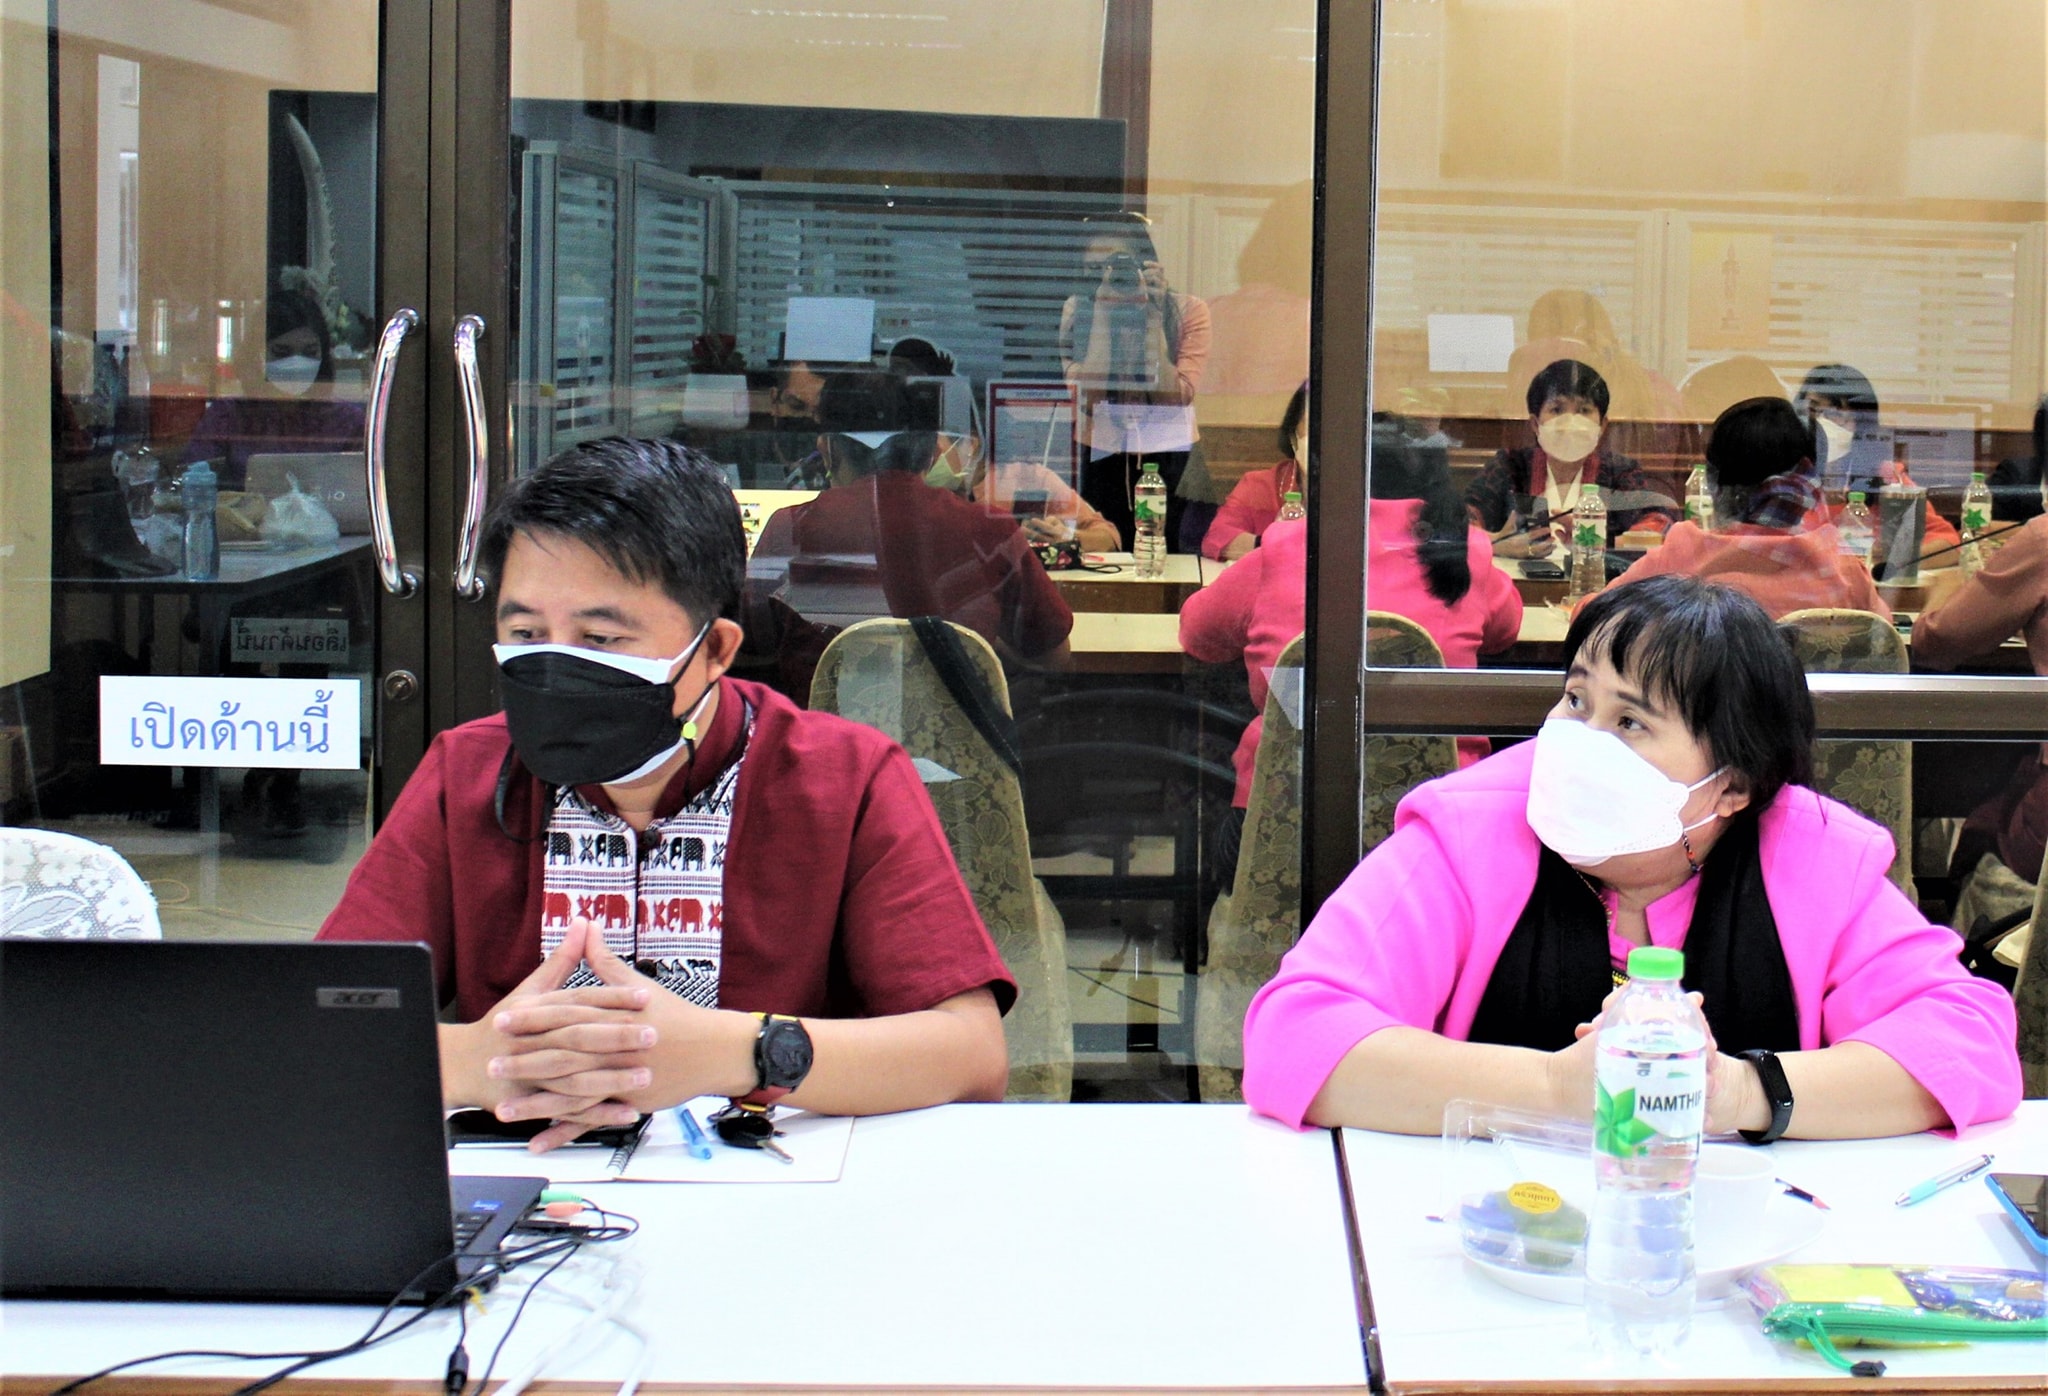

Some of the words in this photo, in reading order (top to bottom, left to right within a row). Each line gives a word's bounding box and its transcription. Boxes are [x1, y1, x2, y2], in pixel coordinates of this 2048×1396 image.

[131, 689, 334, 754] เปิดด้านนี้
[333, 991, 383, 1005] acer
